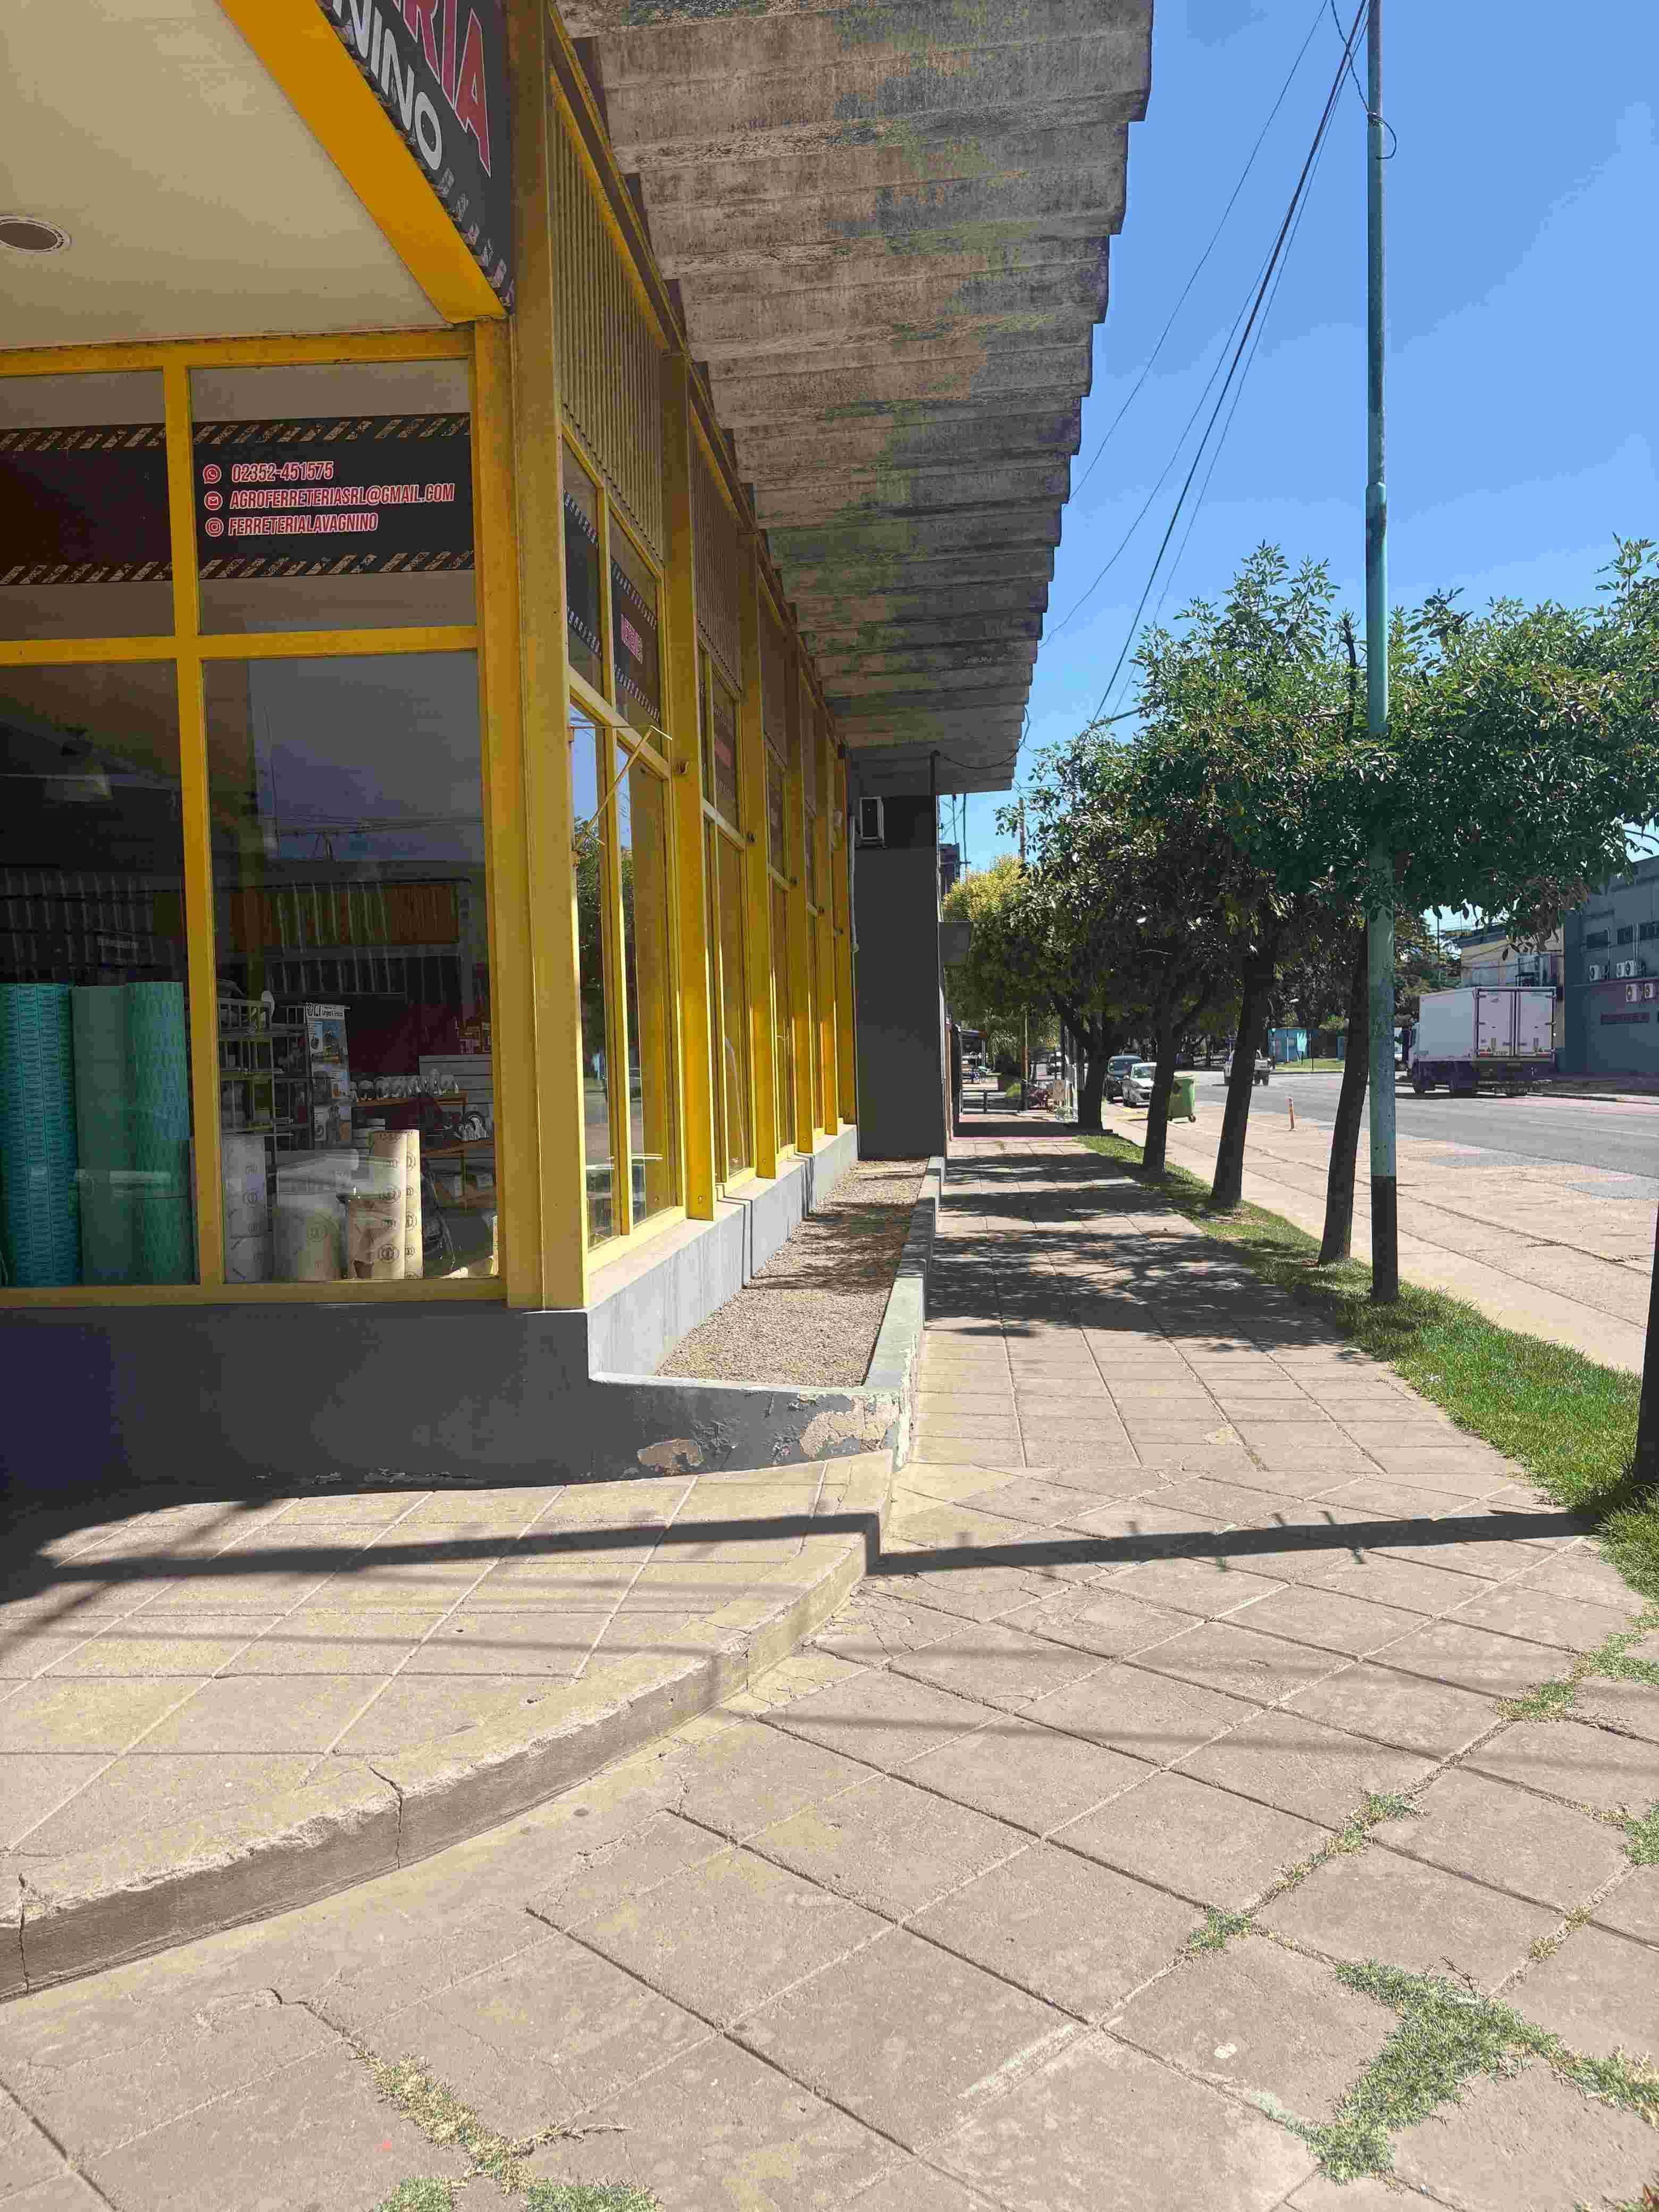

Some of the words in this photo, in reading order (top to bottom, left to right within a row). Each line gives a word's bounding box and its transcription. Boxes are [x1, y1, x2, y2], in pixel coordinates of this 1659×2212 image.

[393, 0, 491, 178] RIA
[232, 462, 334, 483] 02352-451575
[230, 483, 455, 509] AGROFERRETERIASRL@GMAIL.COM
[228, 513, 379, 536] FERRETERIALAVAGNINO
